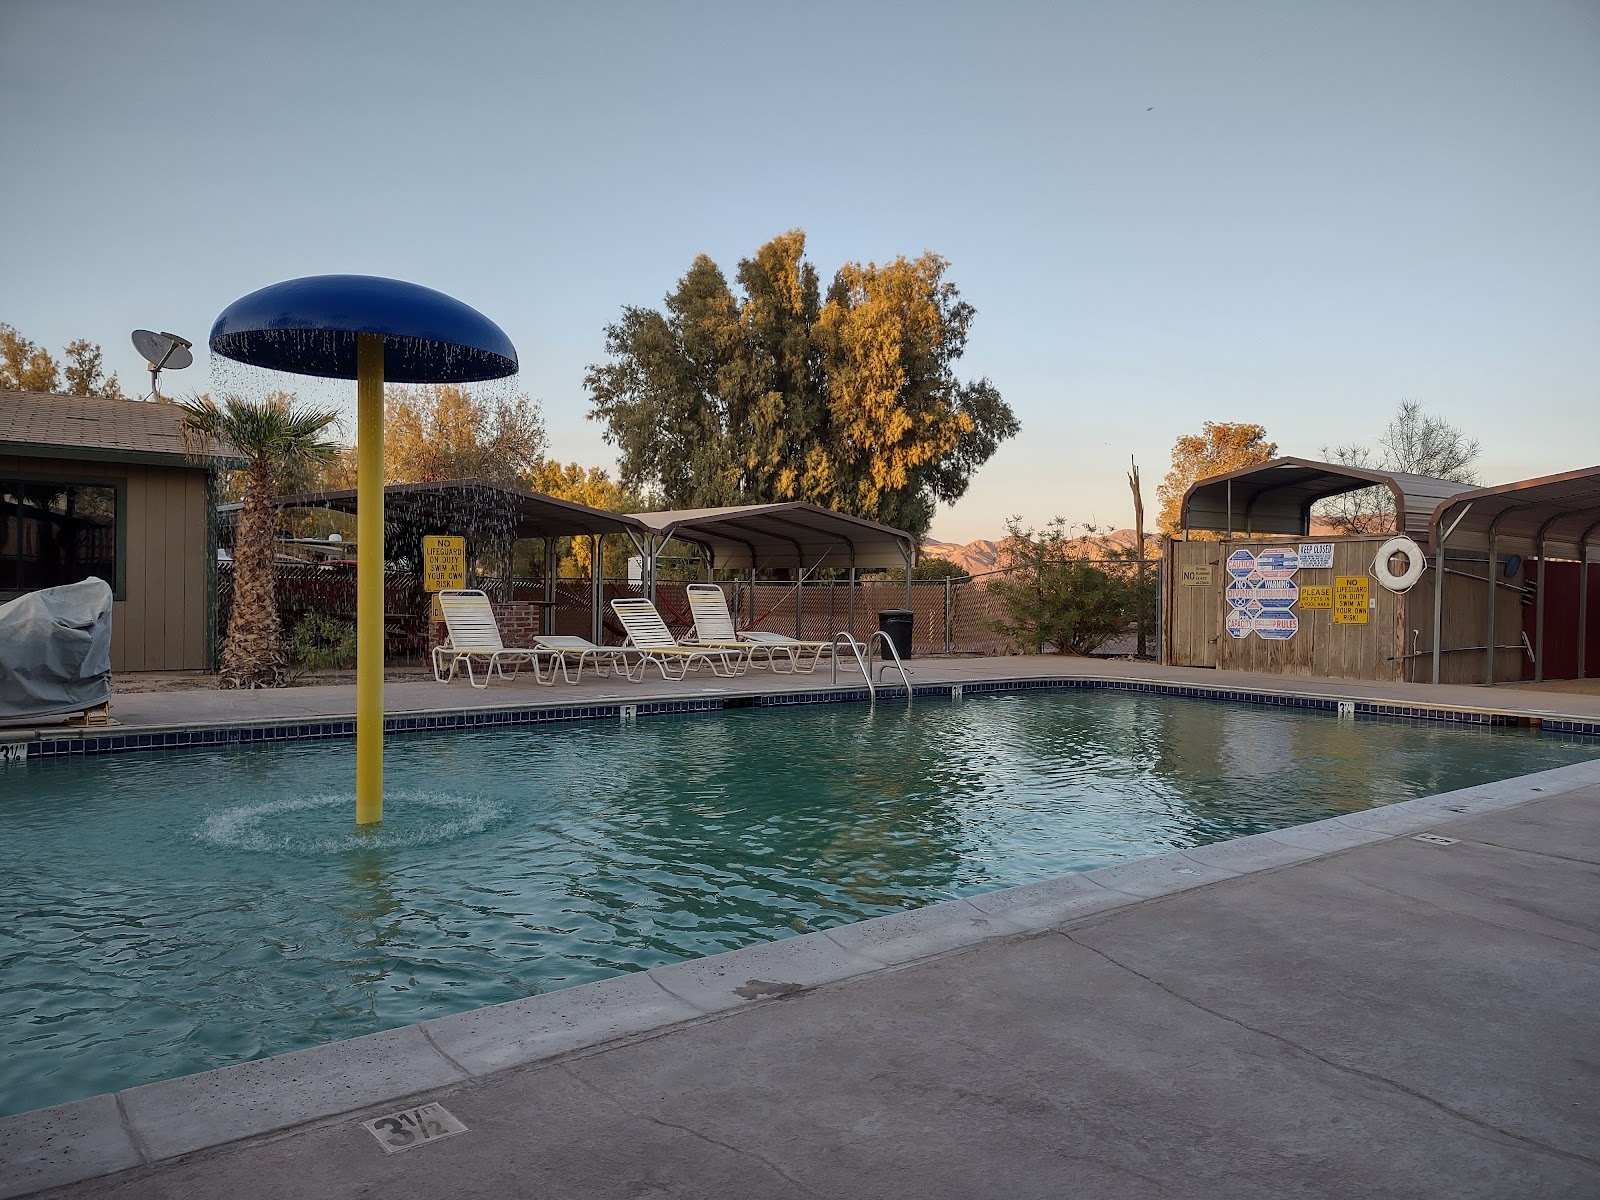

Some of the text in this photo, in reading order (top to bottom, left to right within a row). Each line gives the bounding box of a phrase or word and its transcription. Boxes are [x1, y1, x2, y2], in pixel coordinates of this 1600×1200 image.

[437, 539, 451, 548] NO
[426, 548, 462, 556] LIFEGUARD
[1300, 544, 1332, 554] KEEP CLOSED
[429, 556, 459, 564] ON DUTY
[1228, 560, 1255, 569] CAUTION
[430, 564, 459, 572] SWIM AT
[427, 572, 463, 580] YOUR OWN
[1183, 571, 1195, 580] NO
[435, 580, 454, 588] RISK!
[1235, 580, 1247, 589] NO
[1264, 580, 1290, 589] WARNING
[1227, 589, 1254, 598] DIVING
[1301, 588, 1330, 596] PLEASE
[1228, 619, 1252, 628] CAPACITY
[1276, 620, 1297, 628] RULES
